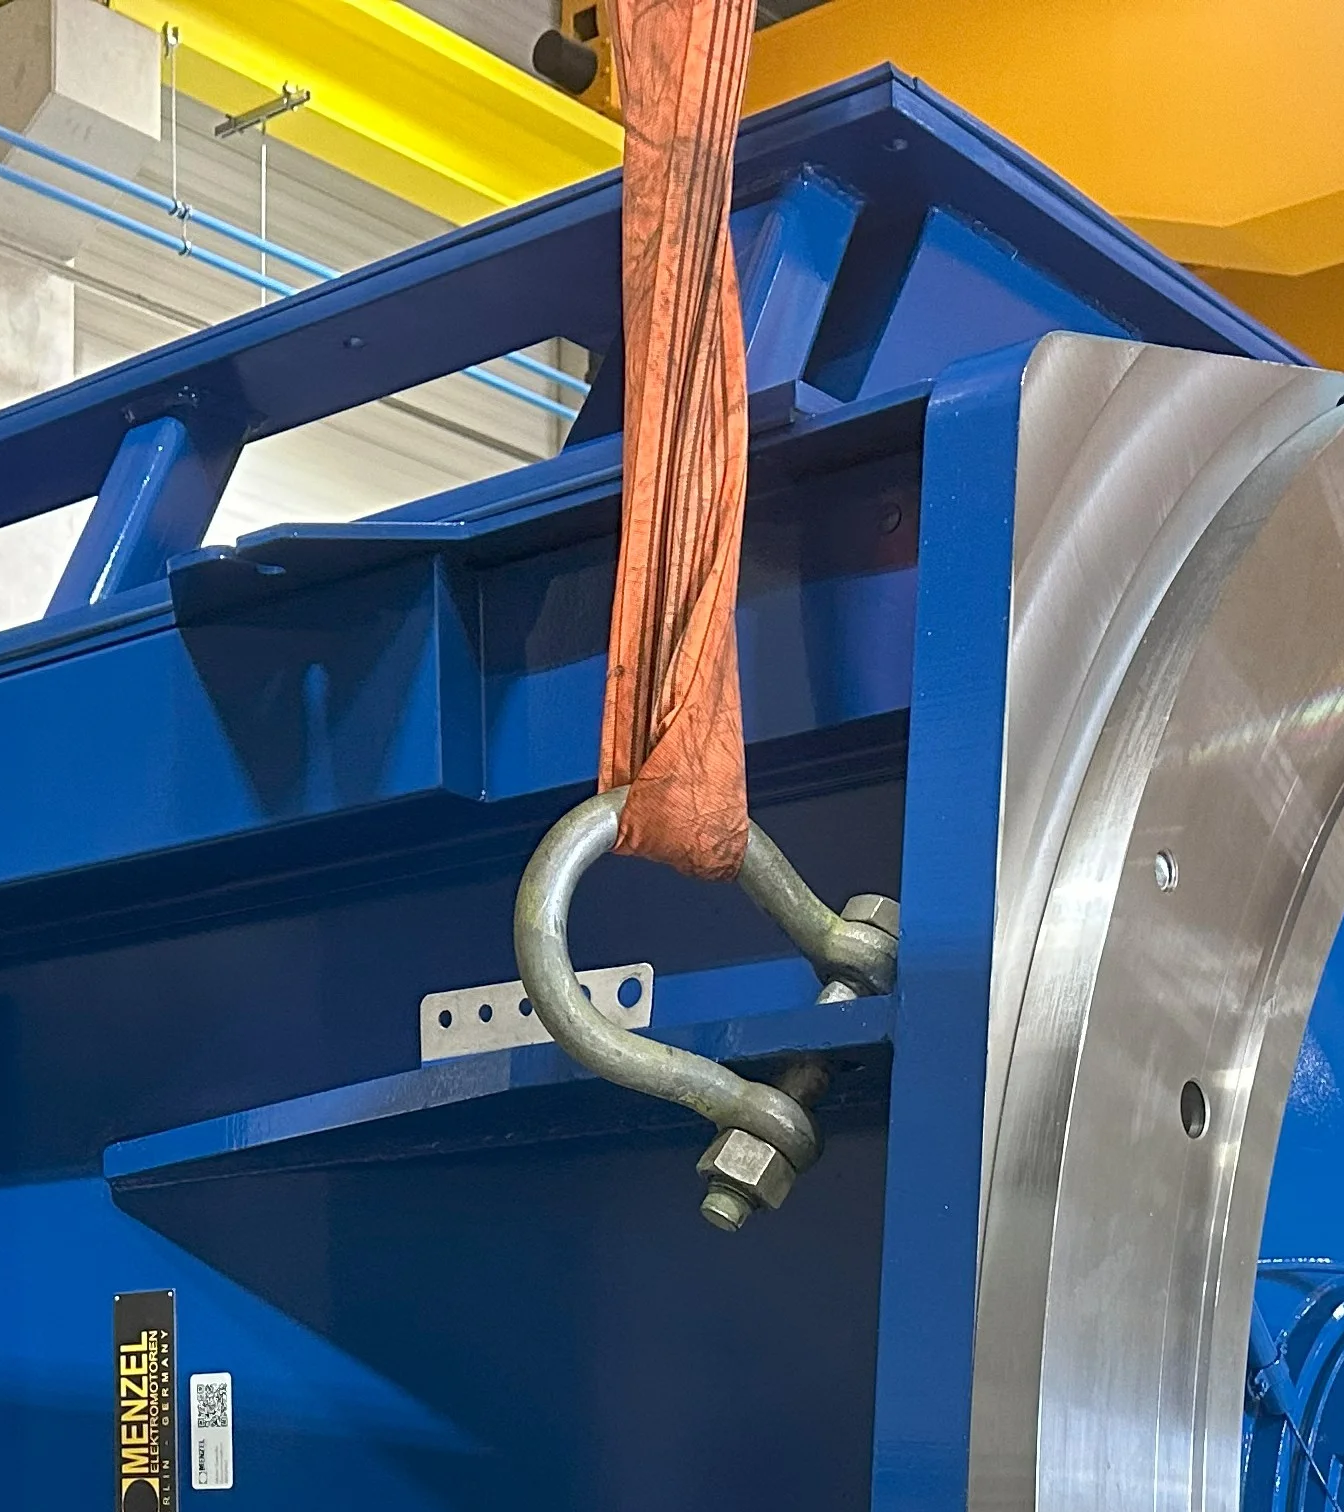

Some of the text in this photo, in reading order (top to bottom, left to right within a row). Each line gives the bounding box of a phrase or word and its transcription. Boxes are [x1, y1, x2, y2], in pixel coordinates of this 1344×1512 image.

[120, 1331, 148, 1474] MENZEL
[149, 1329, 160, 1474] ELEKTROMOTOREN
[161, 1329, 170, 1426] GERMANY
[198, 1439, 206, 1471] MENZEL
